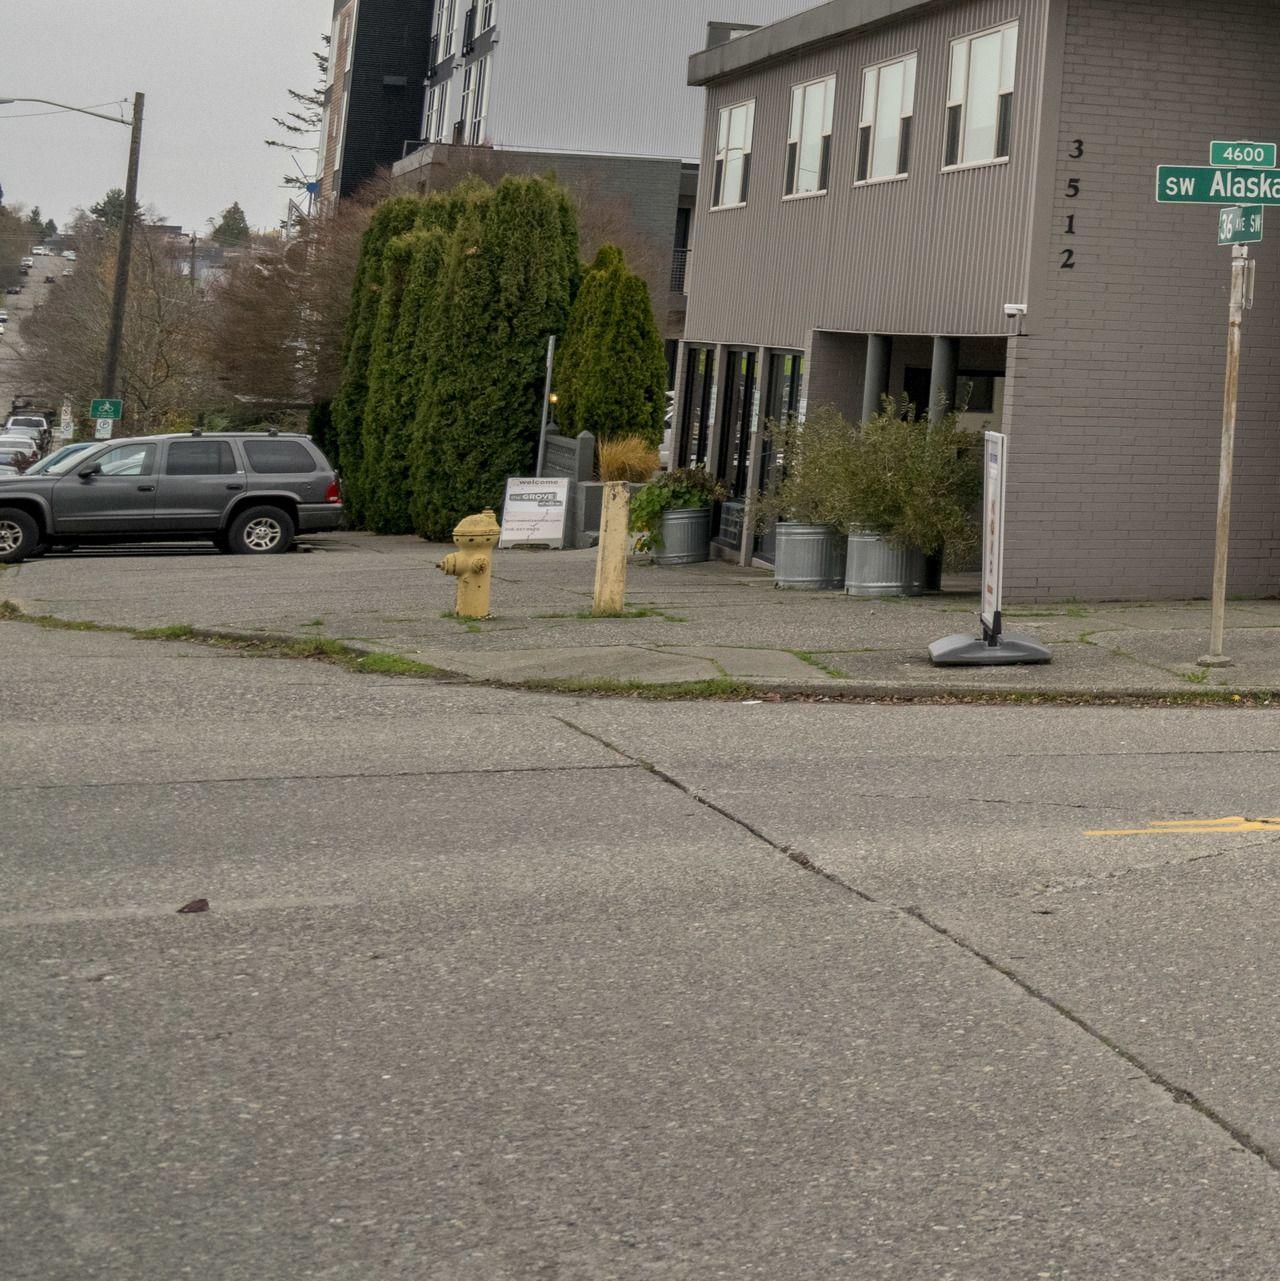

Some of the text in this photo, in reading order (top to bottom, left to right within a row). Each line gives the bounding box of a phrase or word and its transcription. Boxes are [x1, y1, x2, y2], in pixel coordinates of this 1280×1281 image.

[1223, 147, 1265, 163] 4600
[1165, 176, 1196, 196] SW
[1220, 213, 1234, 240] 36
[522, 493, 554, 501] GROVE
